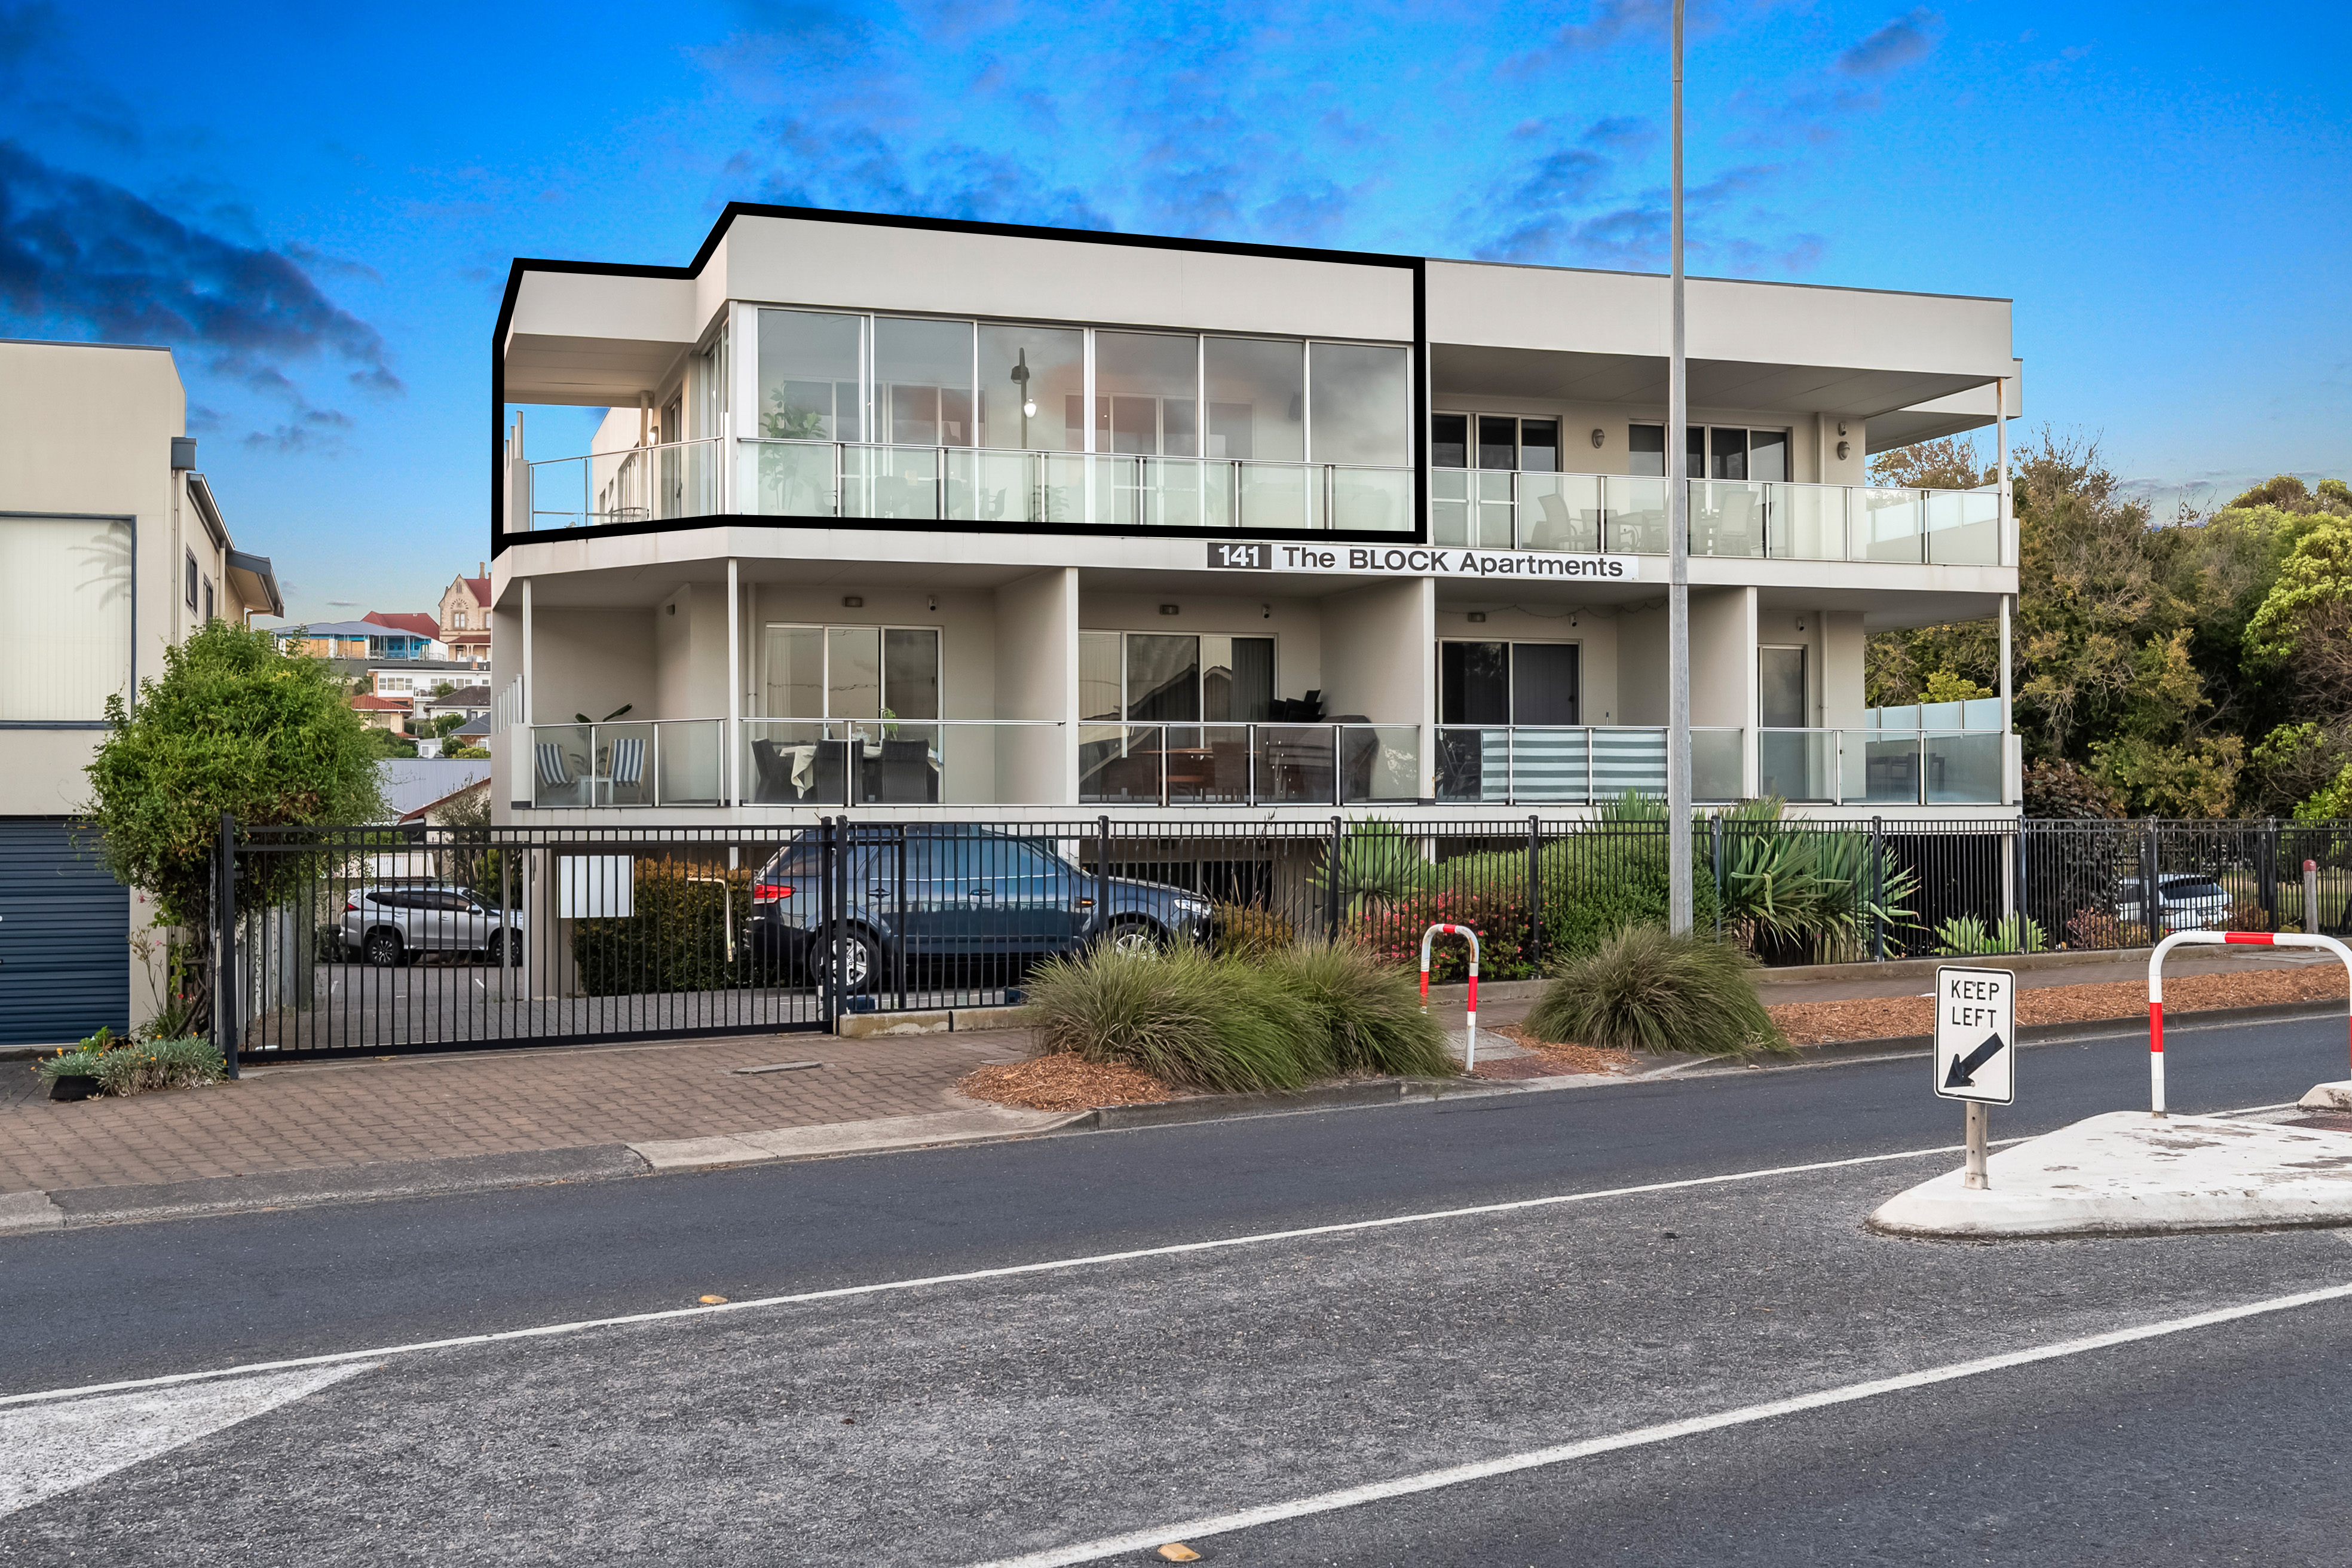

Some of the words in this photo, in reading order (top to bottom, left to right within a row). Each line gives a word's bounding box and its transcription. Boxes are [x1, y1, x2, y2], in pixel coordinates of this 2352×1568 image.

[1218, 545, 1260, 566] 141
[1282, 547, 1336, 568] The
[1349, 549, 1449, 571] BLOCK
[1459, 552, 1624, 576] Apartments
[1951, 979, 1999, 1001] KEEP
[1952, 1006, 1996, 1028] LEFT
